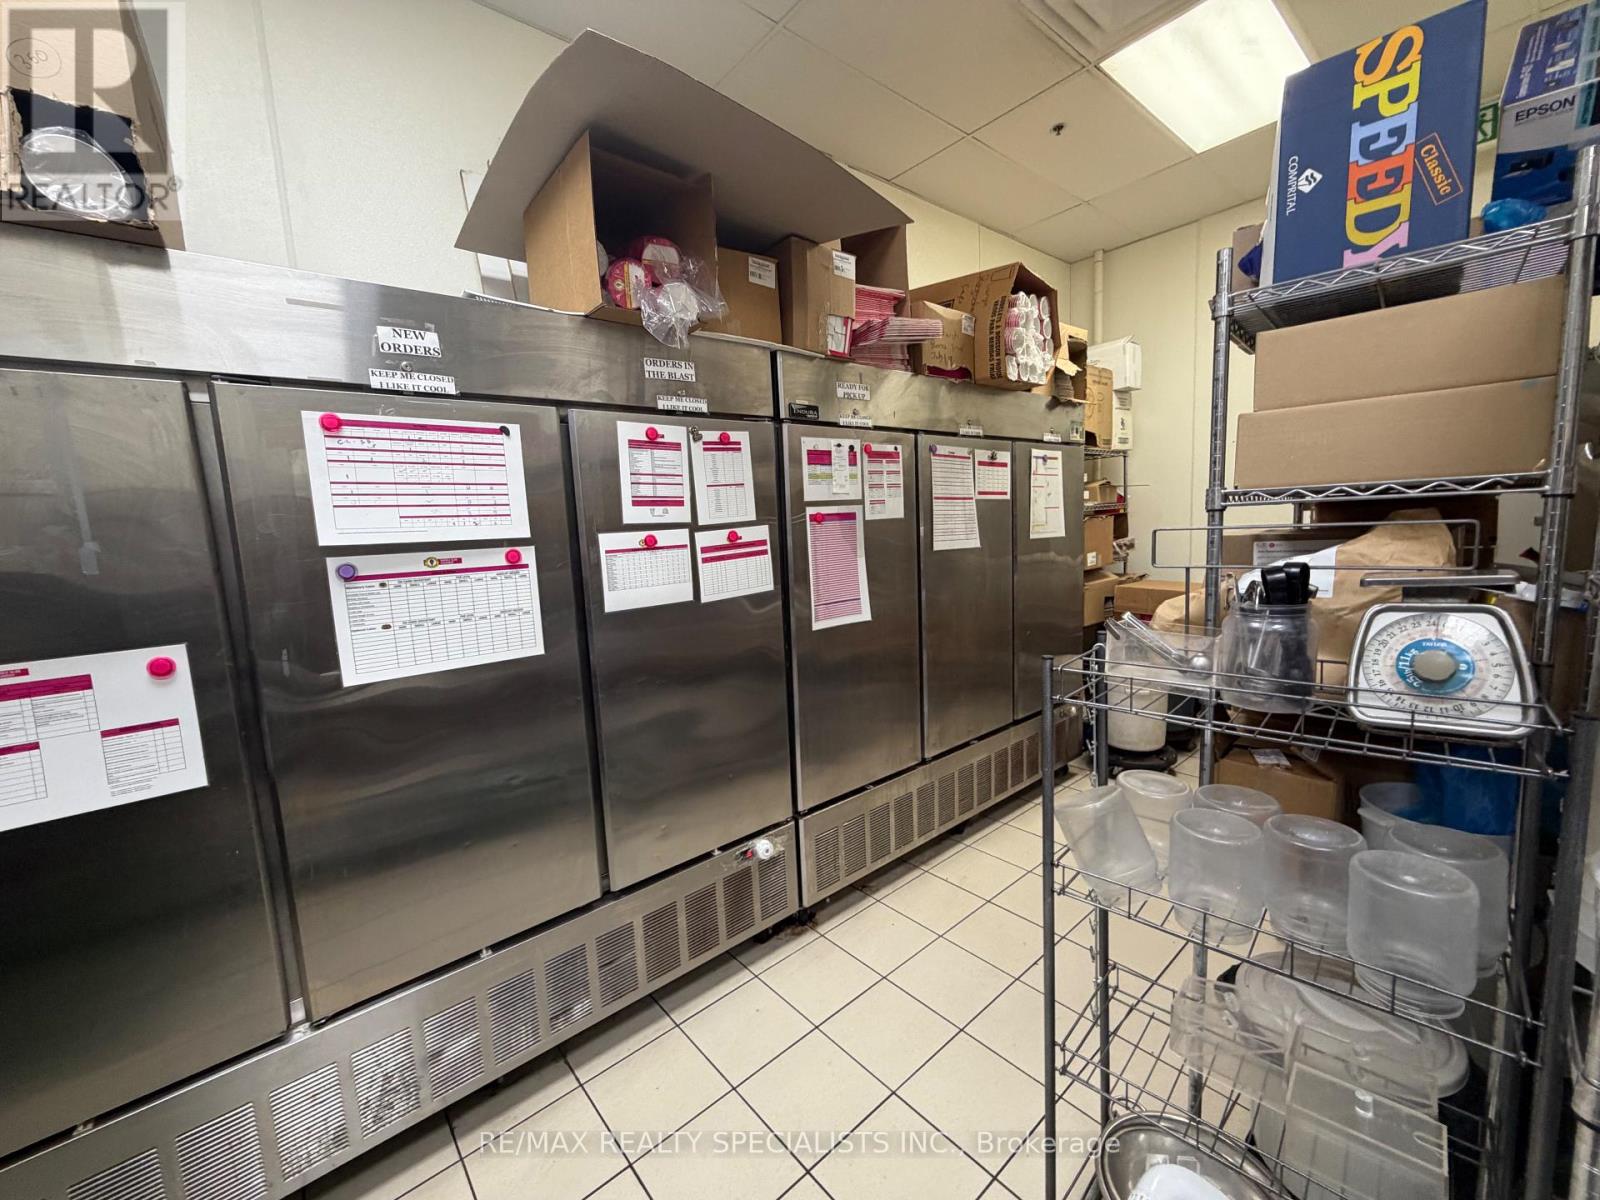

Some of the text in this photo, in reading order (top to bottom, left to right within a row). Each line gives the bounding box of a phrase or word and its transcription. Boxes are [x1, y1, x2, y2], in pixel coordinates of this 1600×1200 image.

[1515, 95, 1576, 122] EPSON
[1343, 25, 1424, 269] SPEEDY
[1420, 143, 1451, 196] Classic
[1286, 155, 1299, 216] COMPRITAL
[392, 328, 426, 340] NEW
[380, 342, 441, 356] ORDERS
[645, 359, 694, 370] ORDERS IN
[370, 369, 455, 383] KEEP ME CLOSED
[646, 370, 695, 380] THE BLAST
[386, 382, 411, 390] LIKE
[423, 385, 448, 393] COOL
[837, 383, 857, 391] READY
[1398, 625, 1408, 633] 22
[1386, 632, 1396, 640] 21
[1379, 639, 1390, 648] 20
[1453, 703, 1465, 712] 10
